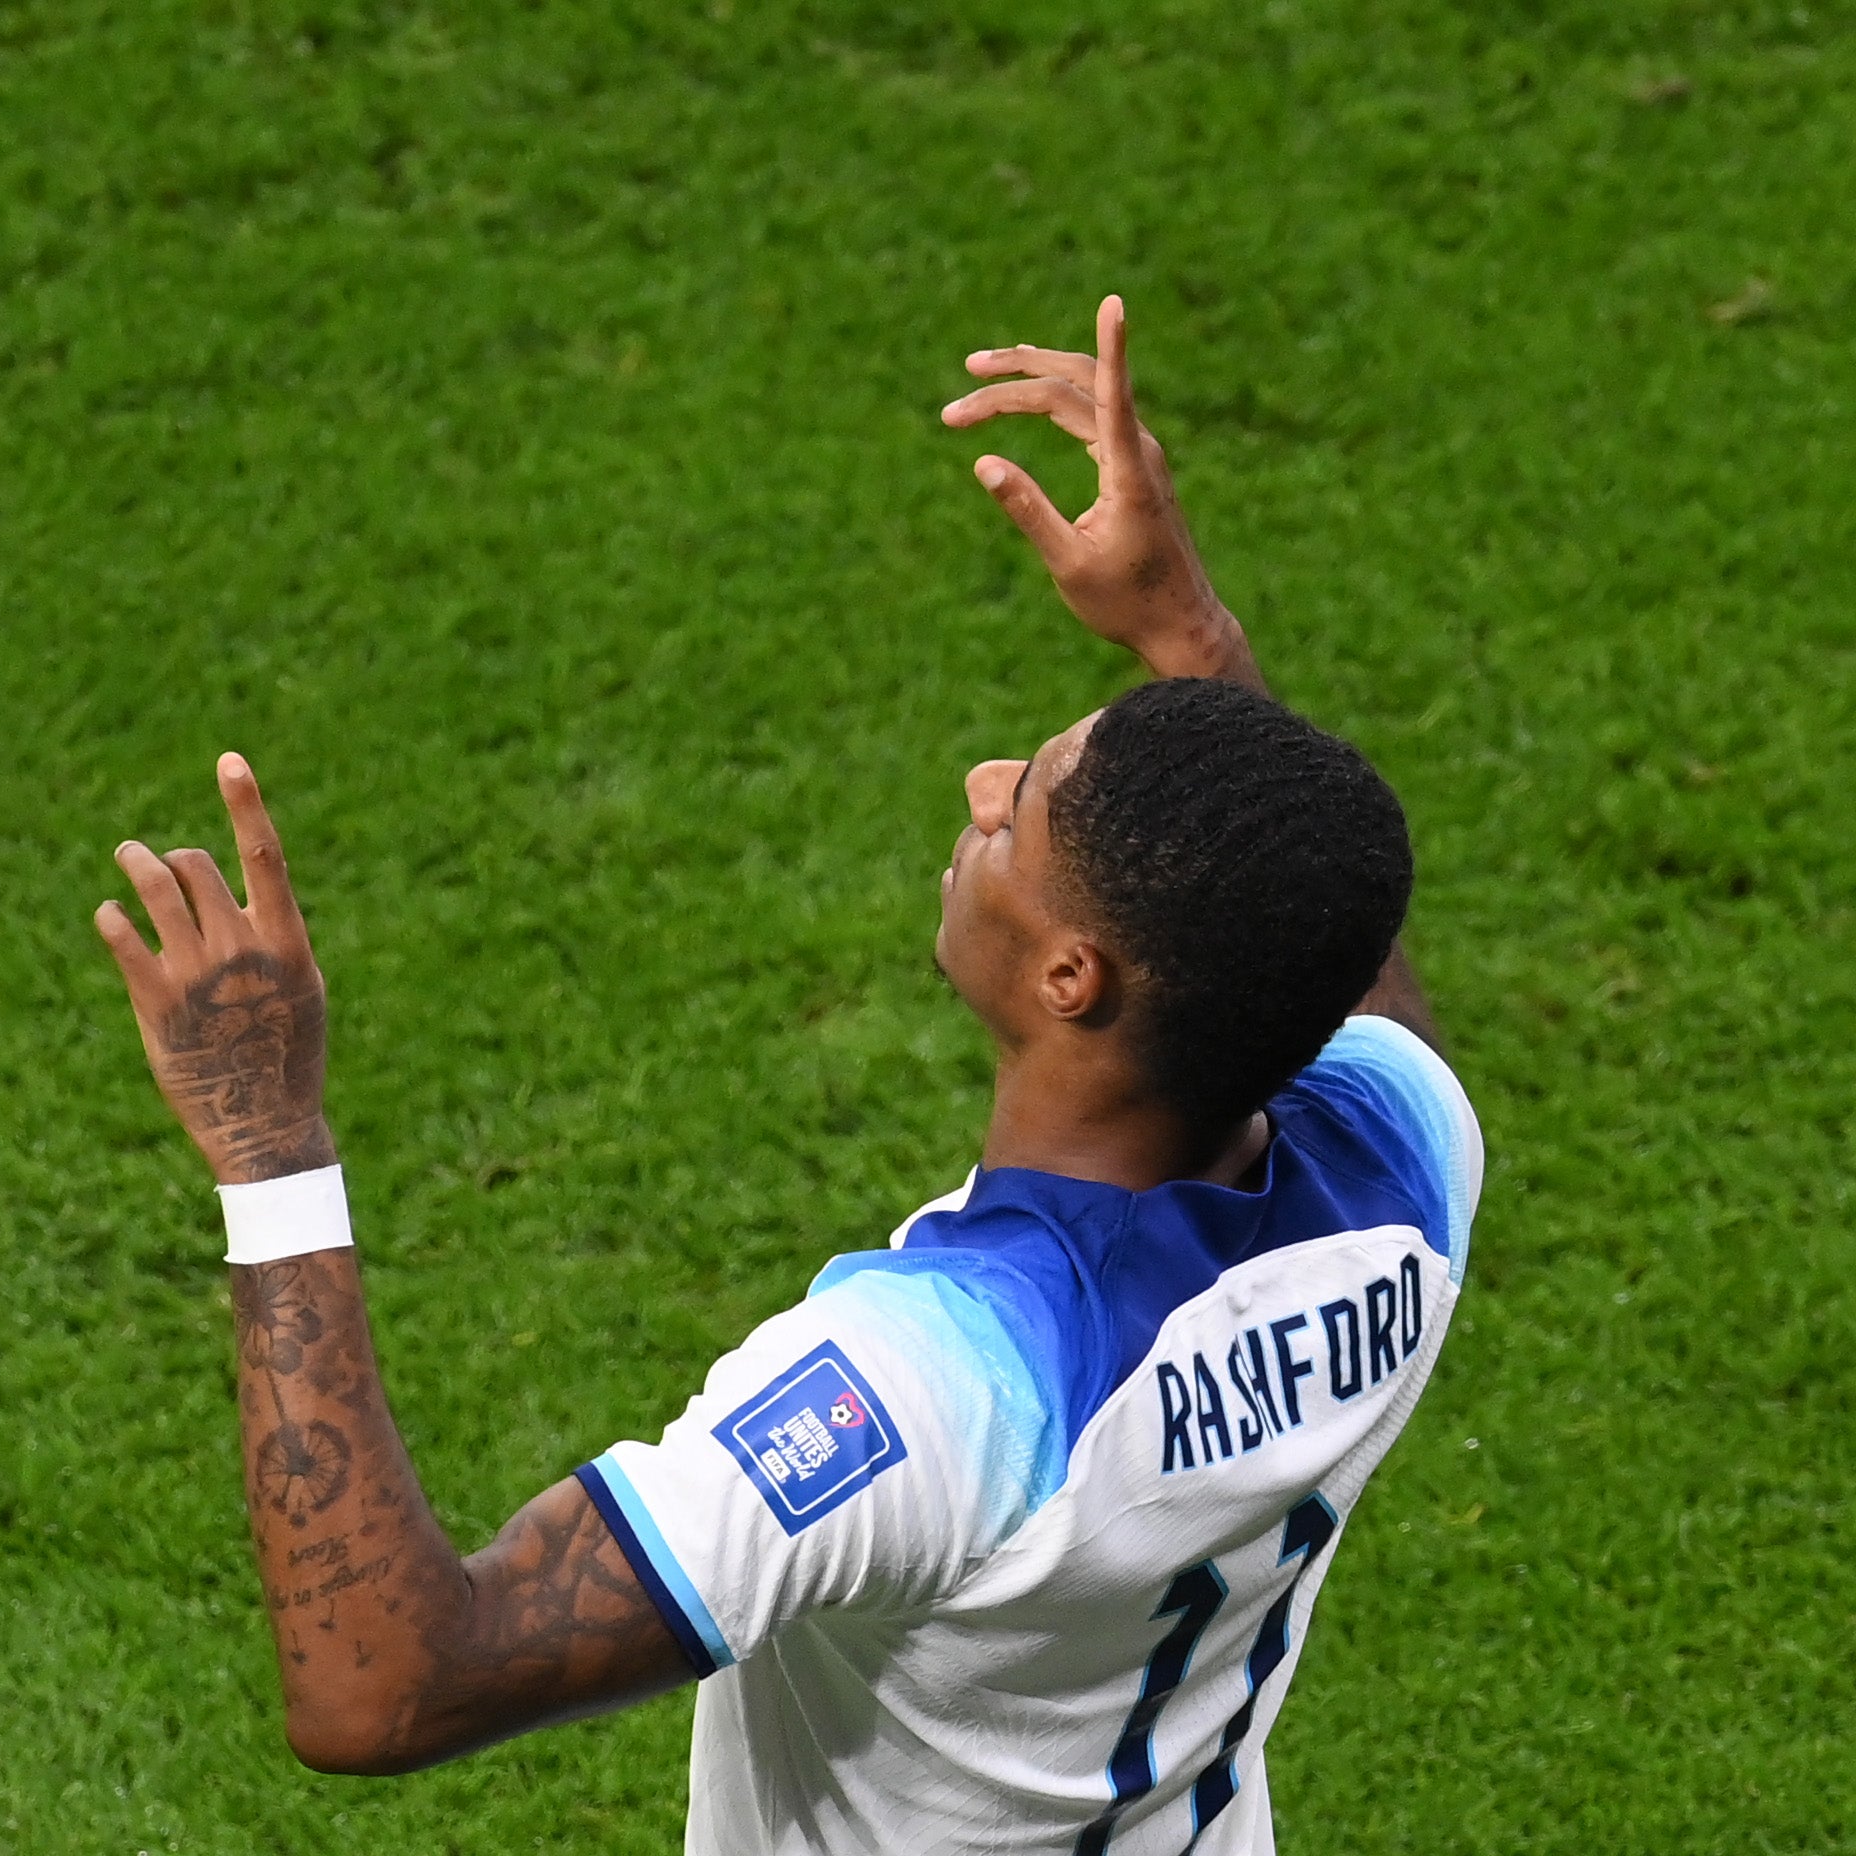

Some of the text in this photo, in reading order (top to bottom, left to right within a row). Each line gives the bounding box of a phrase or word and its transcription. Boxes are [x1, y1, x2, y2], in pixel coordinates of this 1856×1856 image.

[1156, 1252, 1423, 1475] RASHFORD
[783, 1415, 829, 1469] UNITES
[798, 1406, 839, 1458] FOOTBALL
